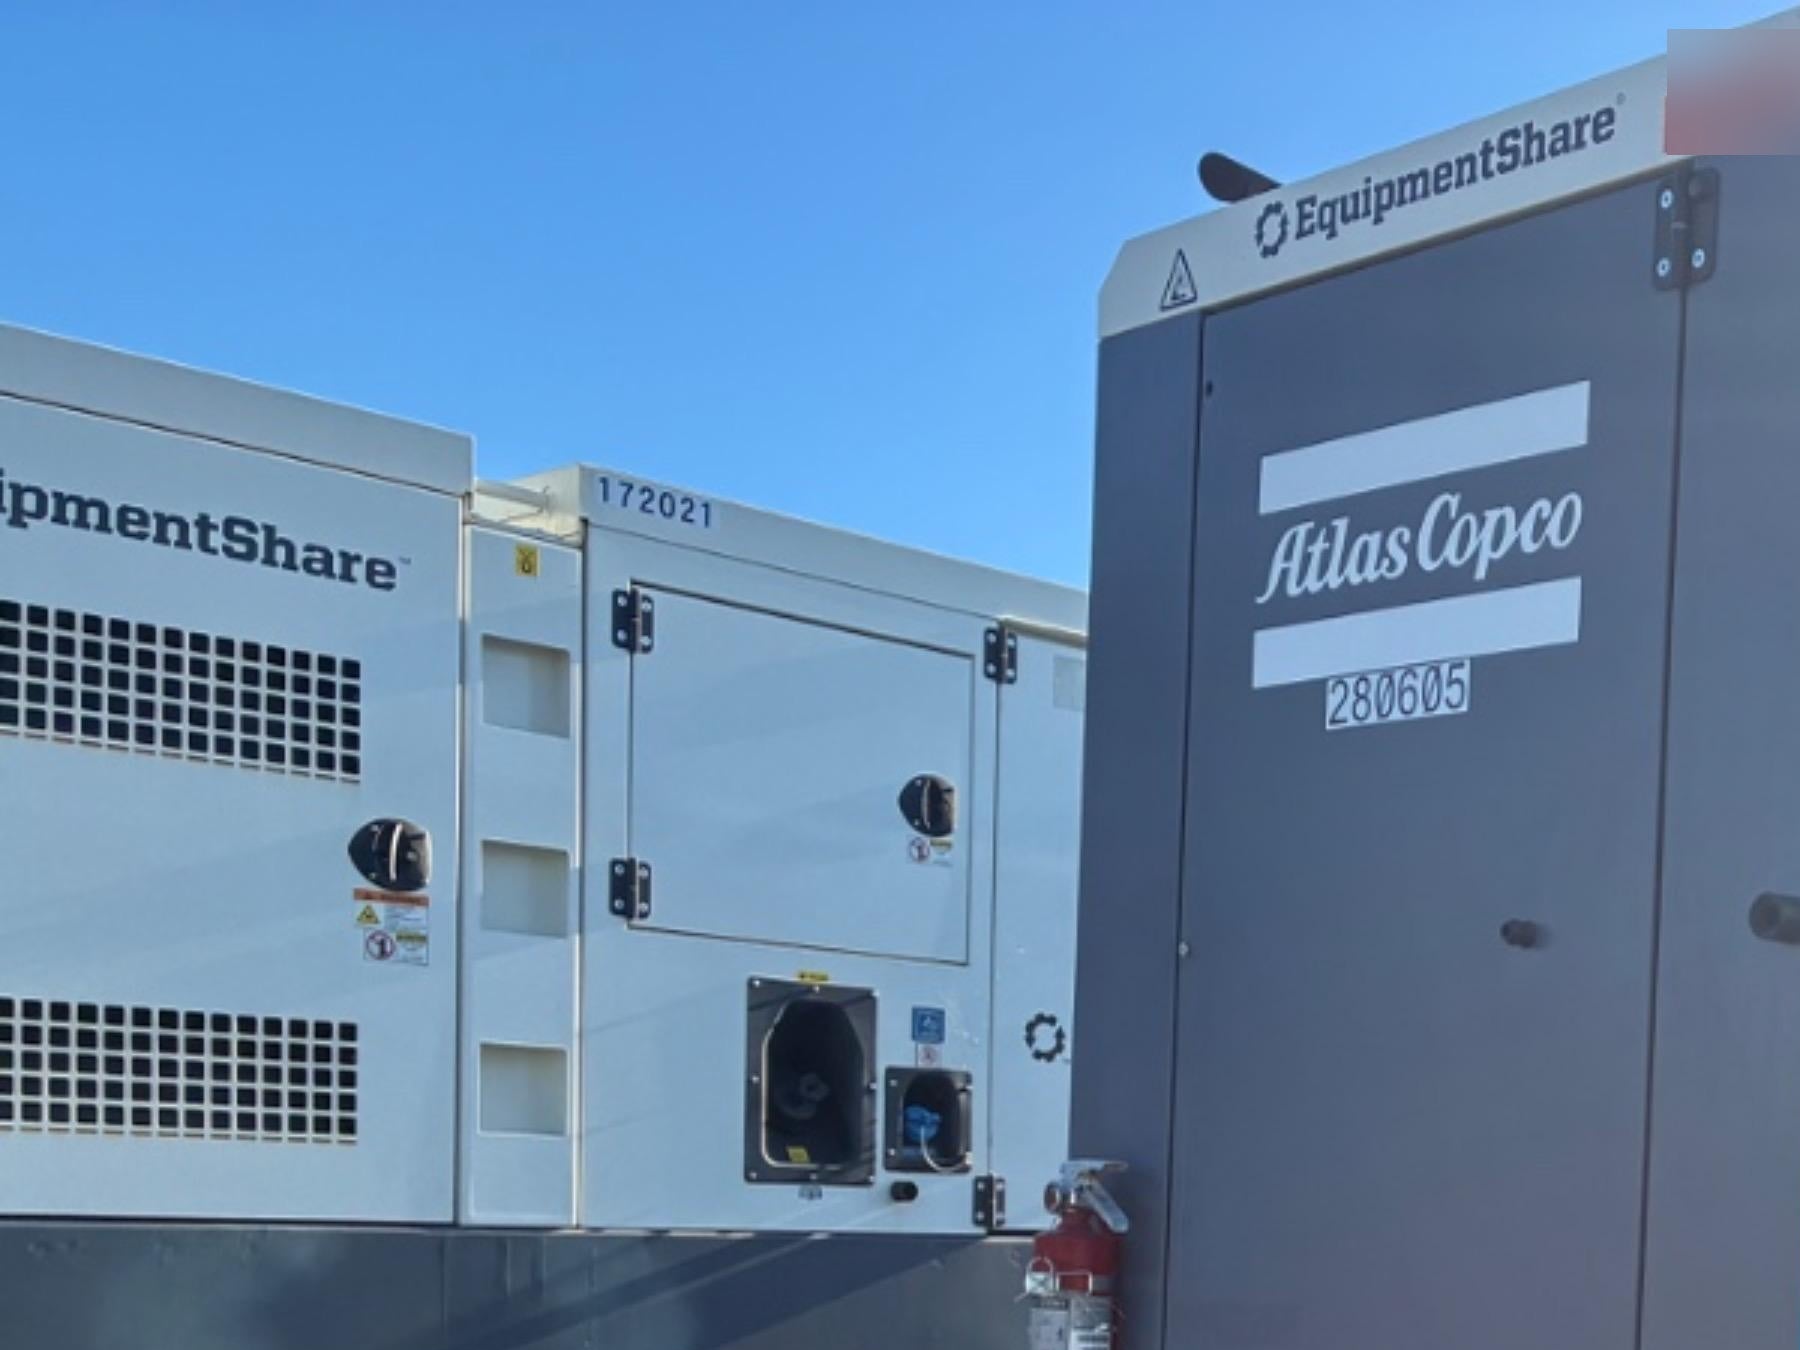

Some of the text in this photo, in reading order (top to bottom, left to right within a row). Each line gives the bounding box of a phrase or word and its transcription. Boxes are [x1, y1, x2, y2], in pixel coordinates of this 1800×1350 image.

[1295, 106, 1616, 240] EquipmentShare
[598, 476, 713, 528] 172021
[1255, 491, 1583, 604] Atlas Copco
[1328, 661, 1468, 726] 280605
